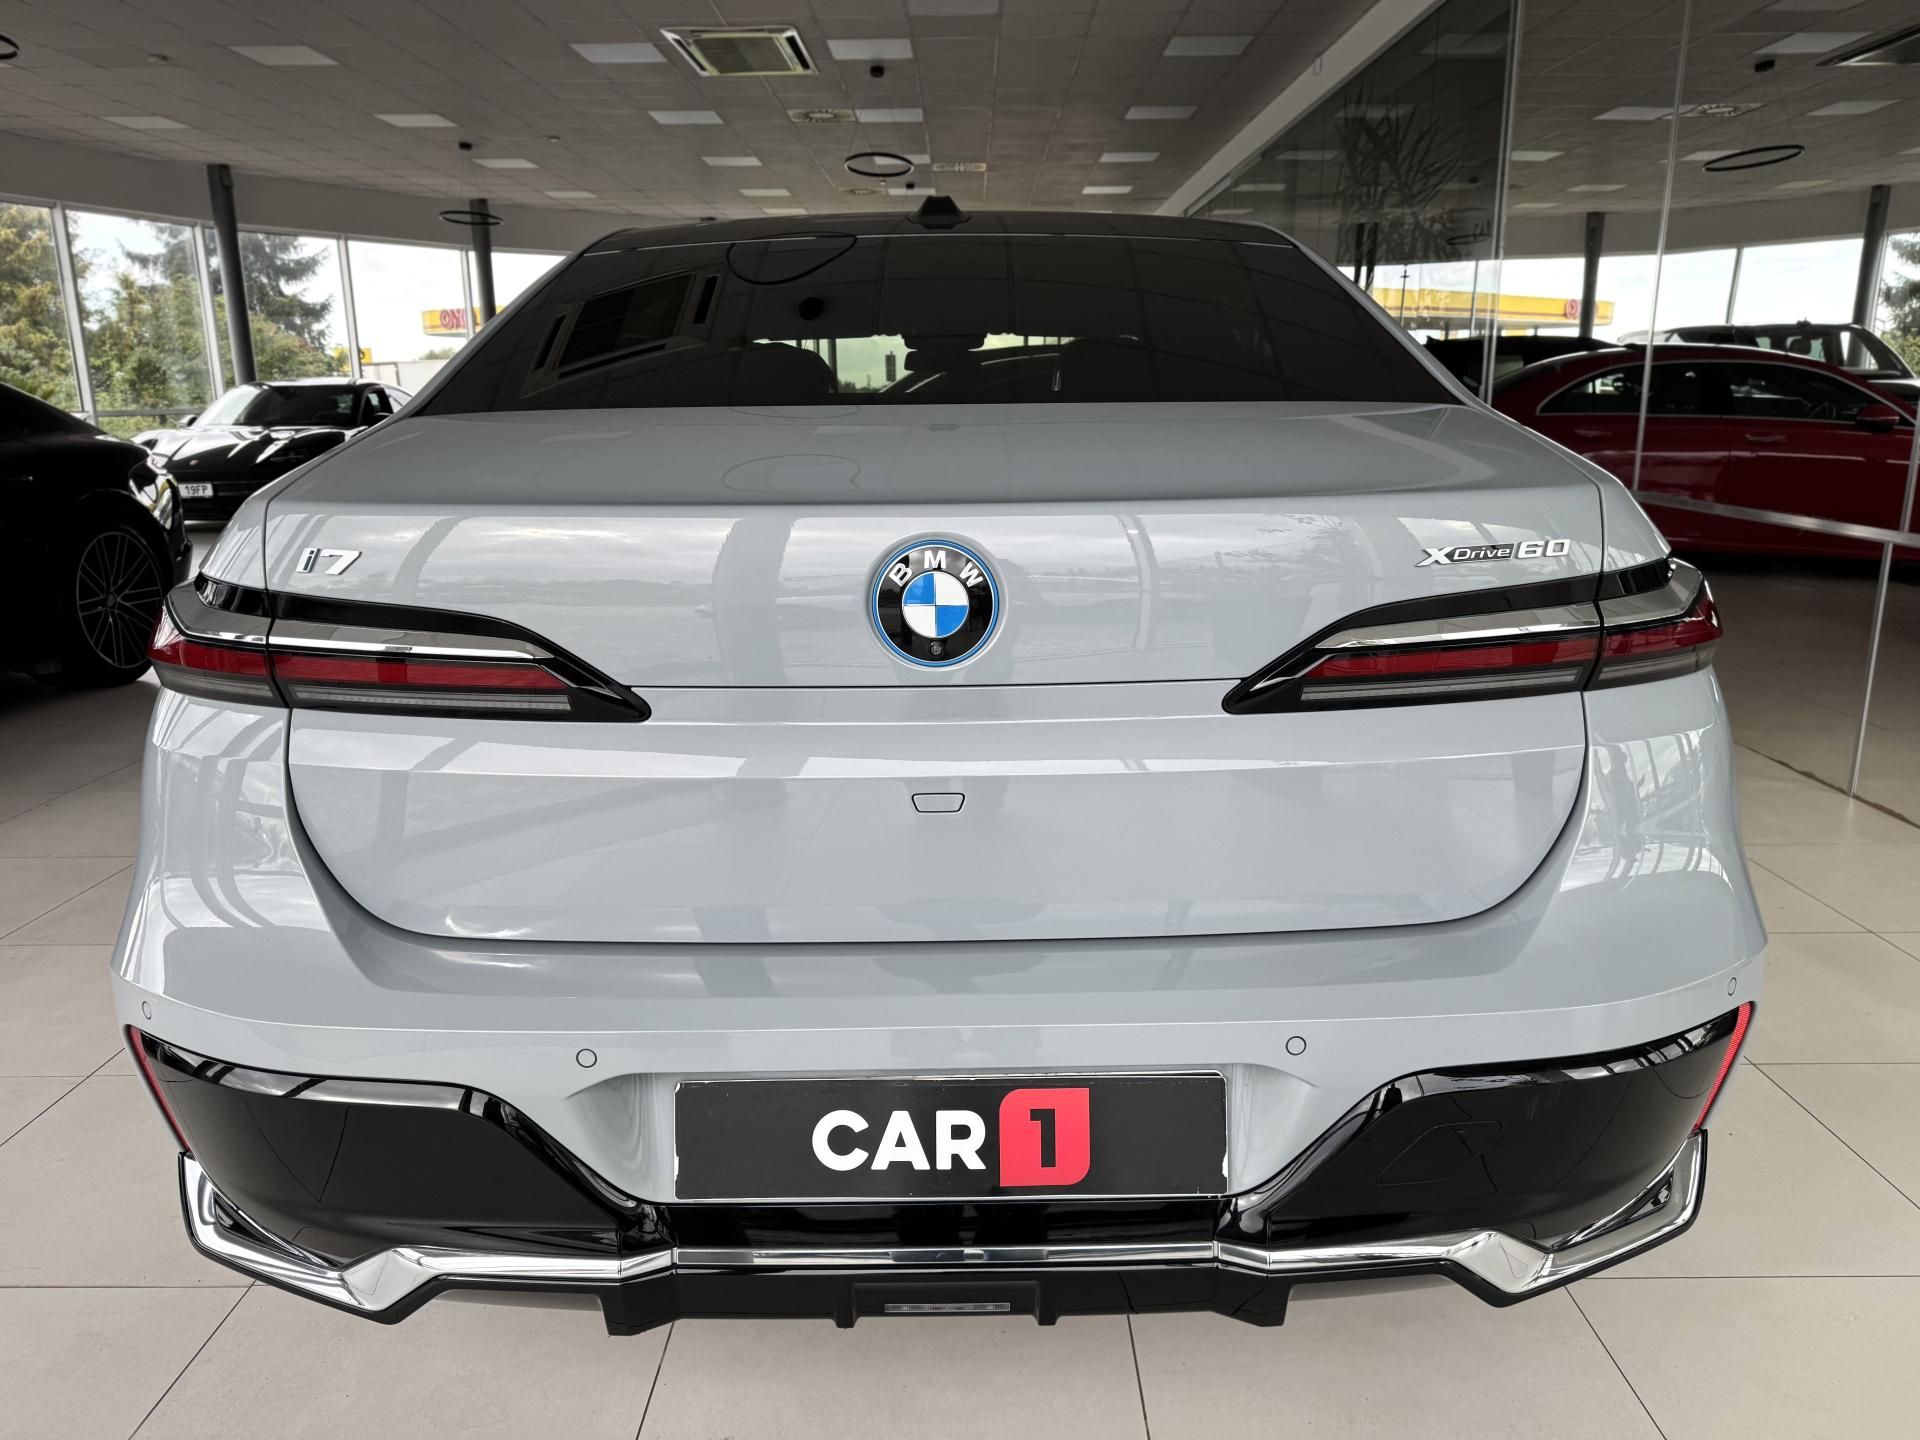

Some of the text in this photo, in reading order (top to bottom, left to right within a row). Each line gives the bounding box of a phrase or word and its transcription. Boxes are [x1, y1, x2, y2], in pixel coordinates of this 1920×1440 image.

[296, 547, 362, 575] i7
[888, 550, 984, 588] BMW
[811, 1108, 1056, 1171] CAR 1
